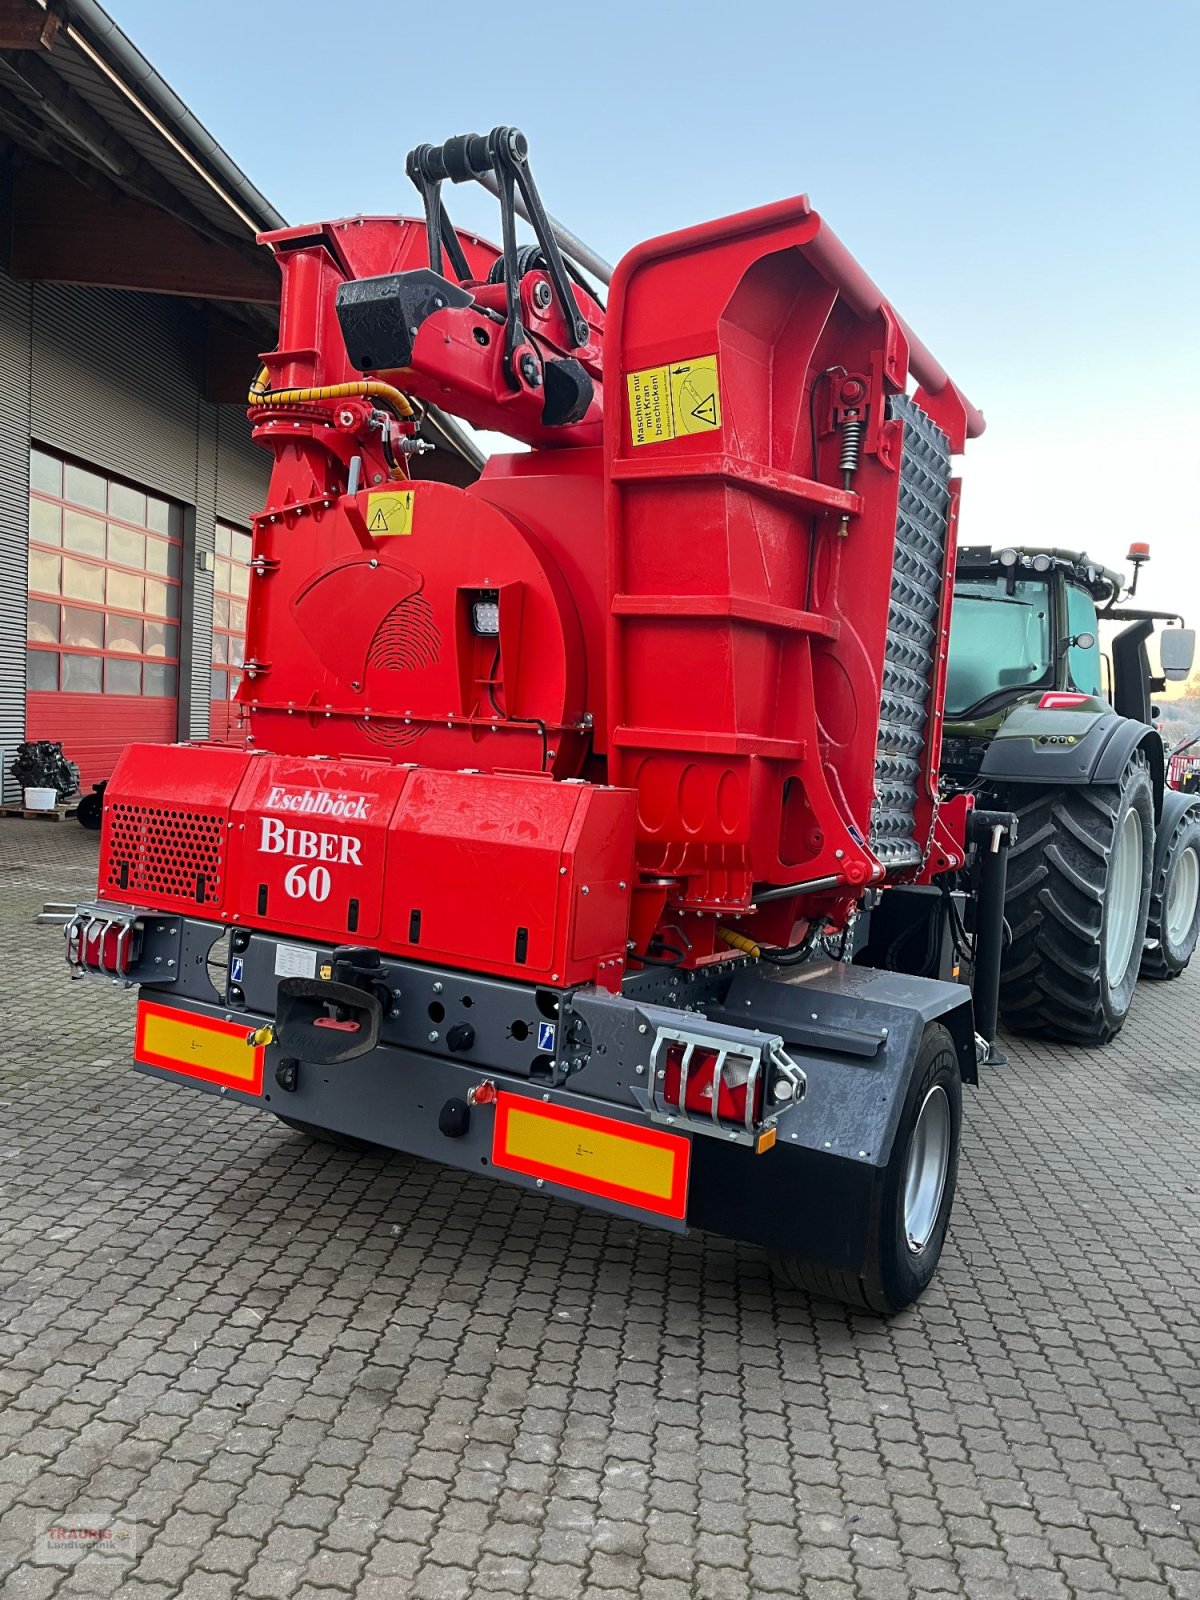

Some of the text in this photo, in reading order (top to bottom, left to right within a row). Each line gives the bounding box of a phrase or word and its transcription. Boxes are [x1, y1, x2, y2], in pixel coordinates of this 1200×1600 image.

[635, 395, 644, 442] Maschine
[643, 385, 653, 428] mit Kran
[650, 374, 662, 435] beschicken!
[265, 786, 371, 820] Eschlböck
[257, 816, 363, 866] BIBER
[284, 863, 331, 902] 60
